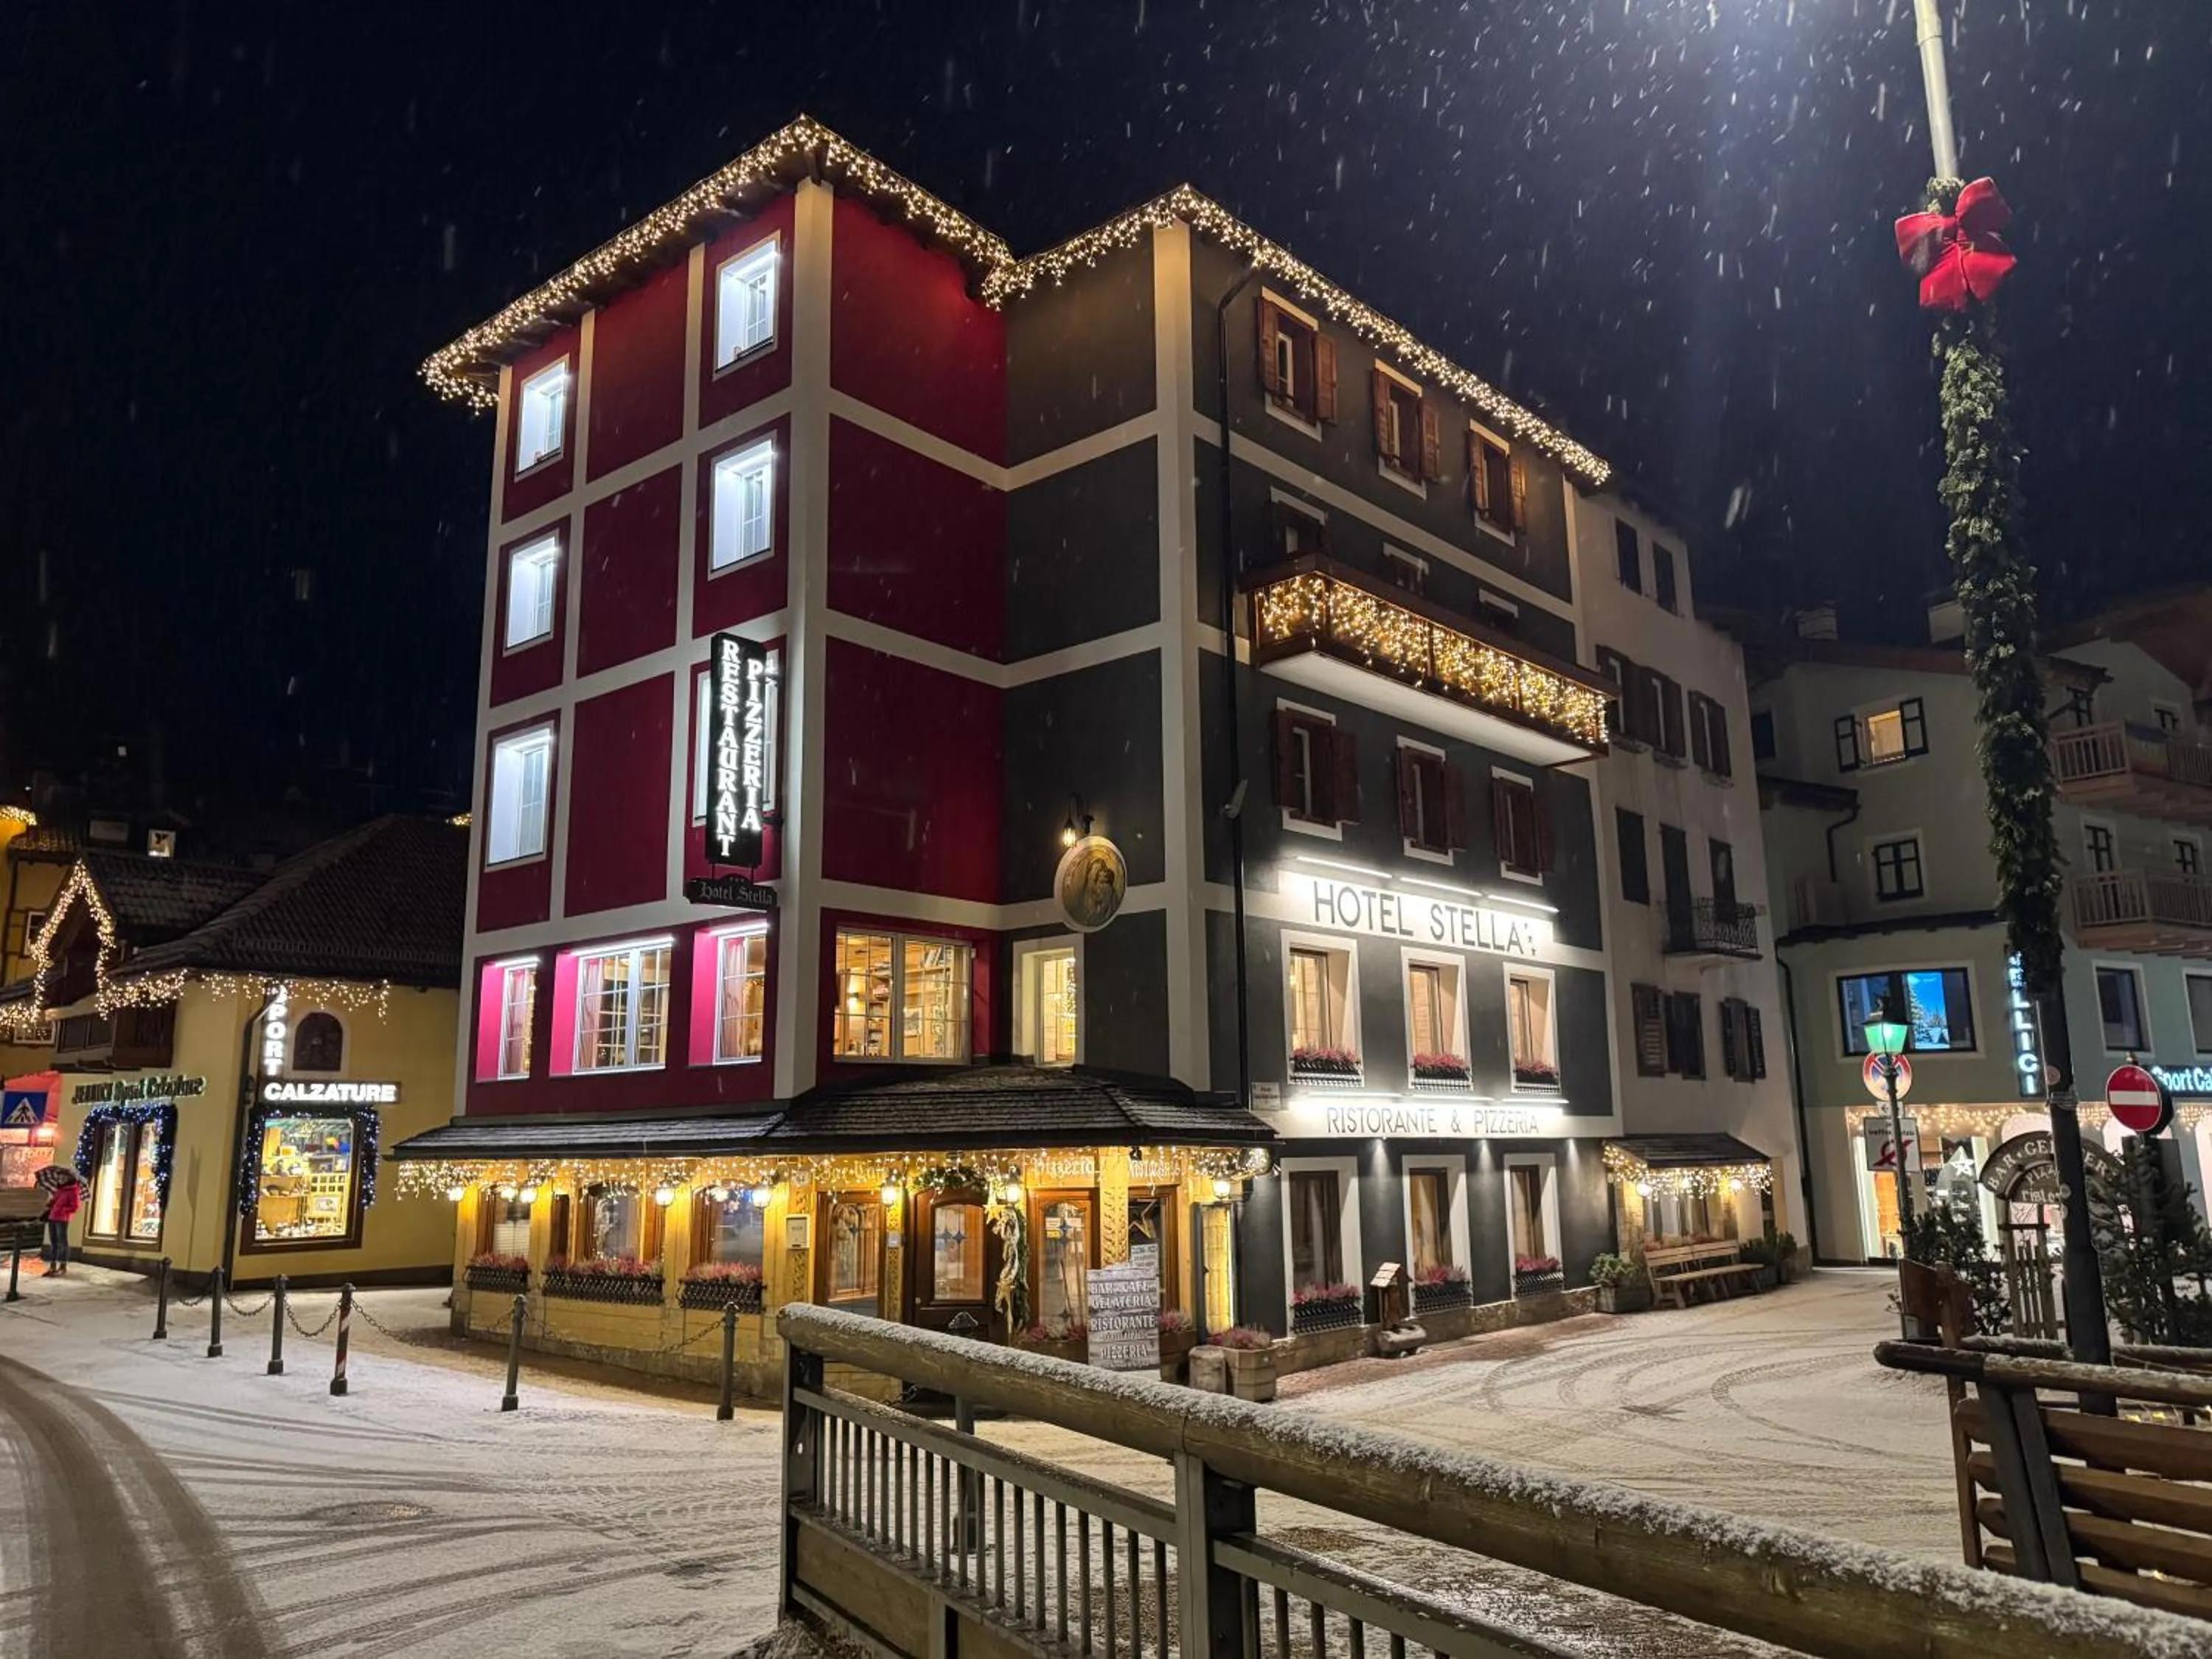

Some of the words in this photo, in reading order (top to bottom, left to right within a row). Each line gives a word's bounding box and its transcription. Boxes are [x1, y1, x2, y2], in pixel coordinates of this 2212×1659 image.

[717, 639, 740, 857] RESTAURANT
[741, 658, 763, 832] PIZZERIA
[700, 882, 733, 900] Hotel
[737, 886, 772, 905] Stella
[1314, 881, 1413, 936] HOTEL
[1430, 903, 1524, 955] STELLA
[264, 1082, 397, 1102] CALZATURE
[1327, 1107, 1438, 1134] RISTORANTE
[1450, 1109, 1462, 1133] &
[1474, 1109, 1540, 1133] PIZZERIA
[1987, 1155, 2017, 1190] BAR
[1092, 1294, 1152, 1310] GELATERIA
[1090, 1315, 1156, 1332] RISTORANTE
[1101, 1343, 1150, 1360] PIZZERIA
